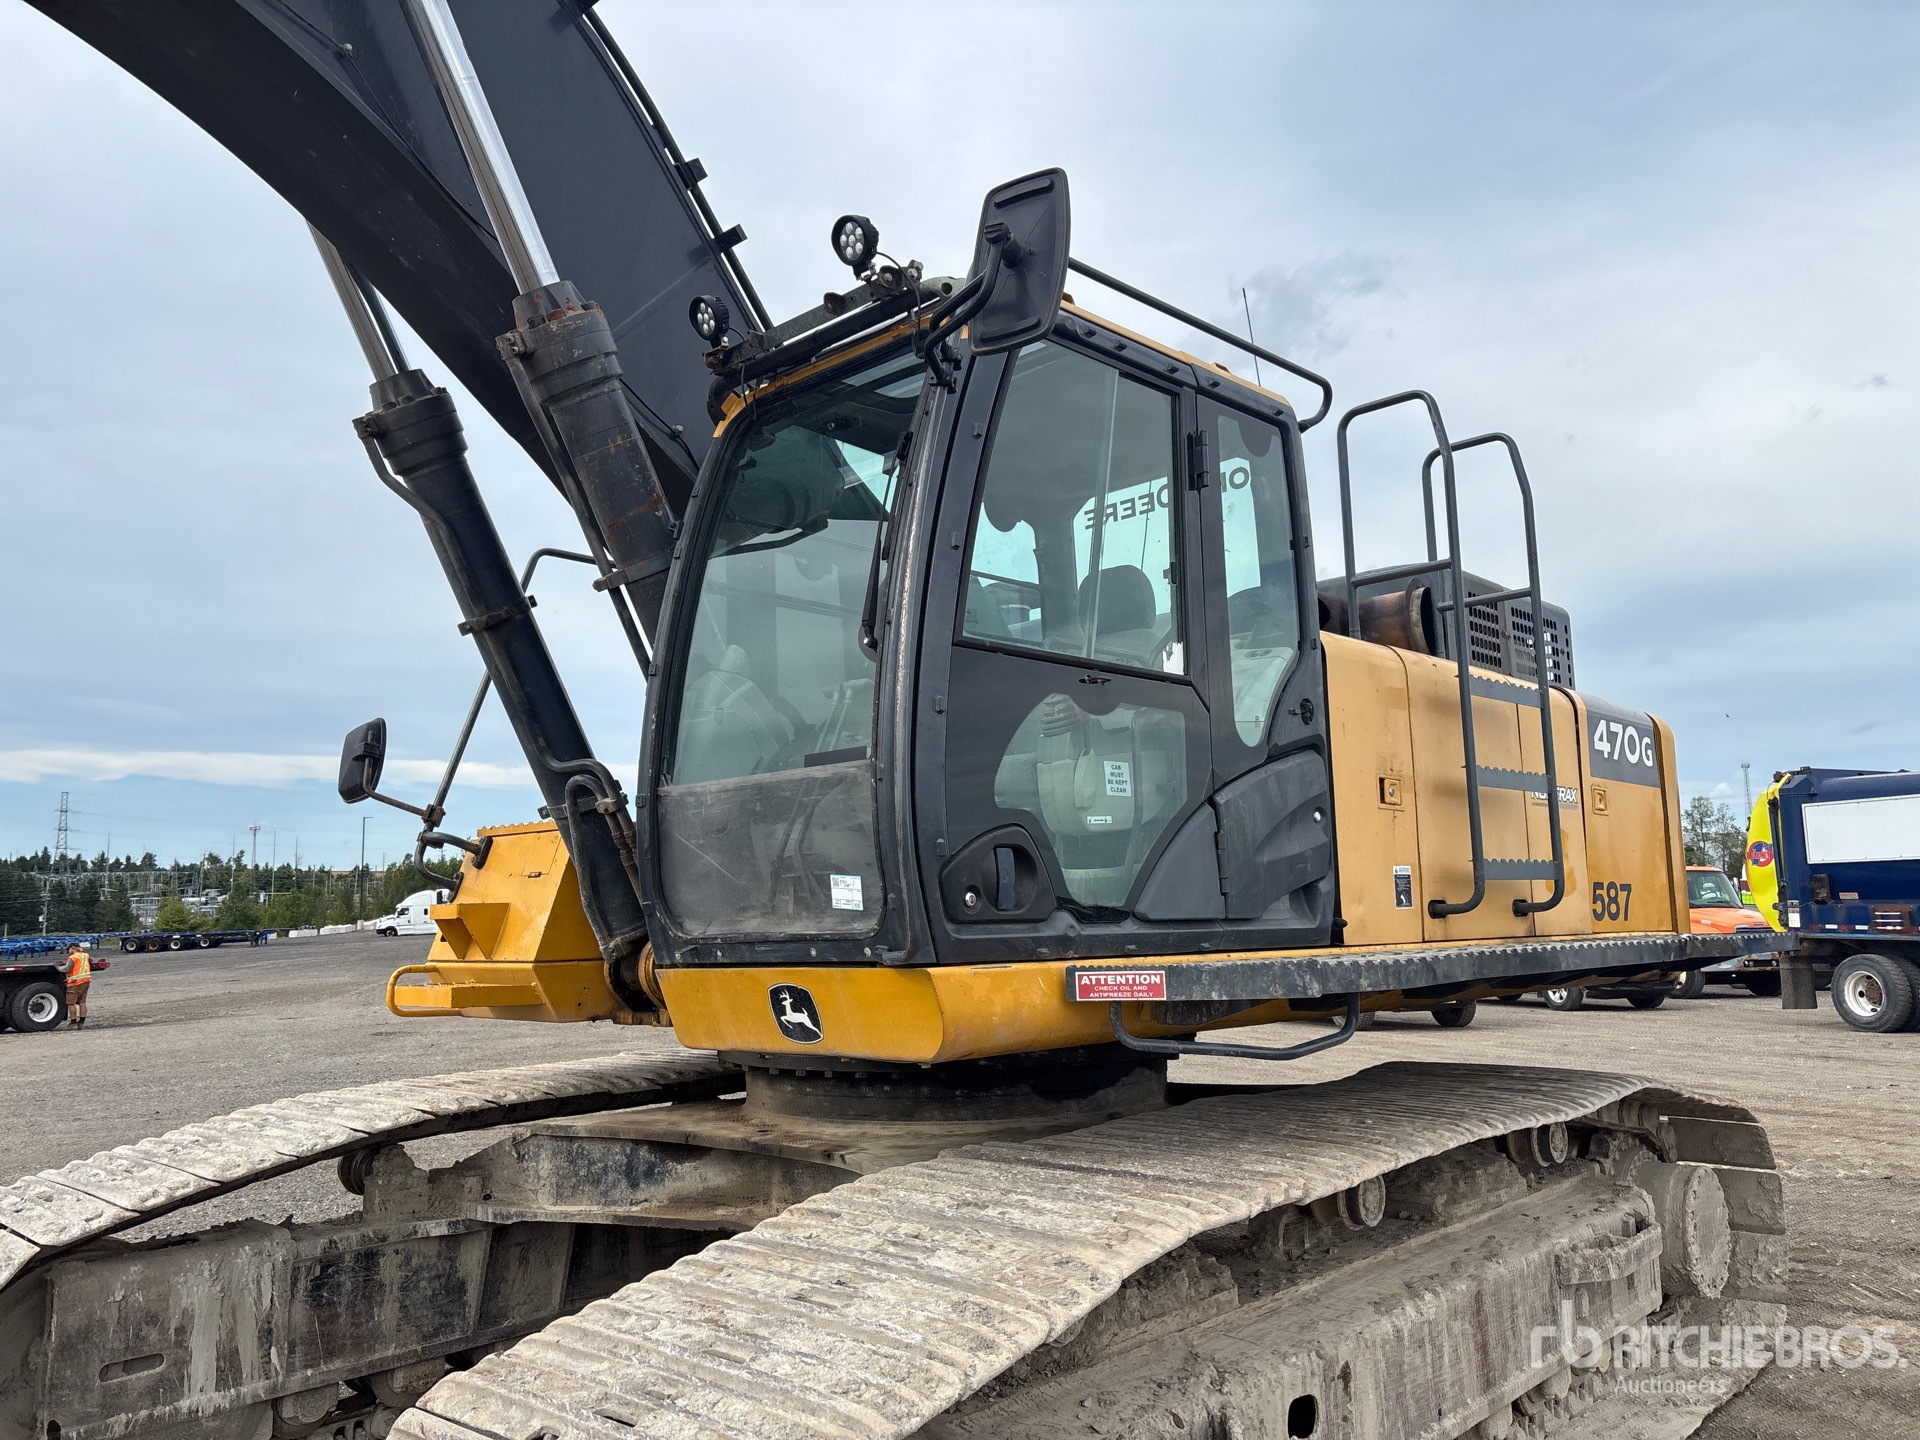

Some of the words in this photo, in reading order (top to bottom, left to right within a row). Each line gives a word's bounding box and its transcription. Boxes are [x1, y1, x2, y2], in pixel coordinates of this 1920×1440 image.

[1593, 719, 1653, 767] 470G
[1592, 881, 1632, 922] 587
[1080, 975, 1161, 985] ATTENTION
